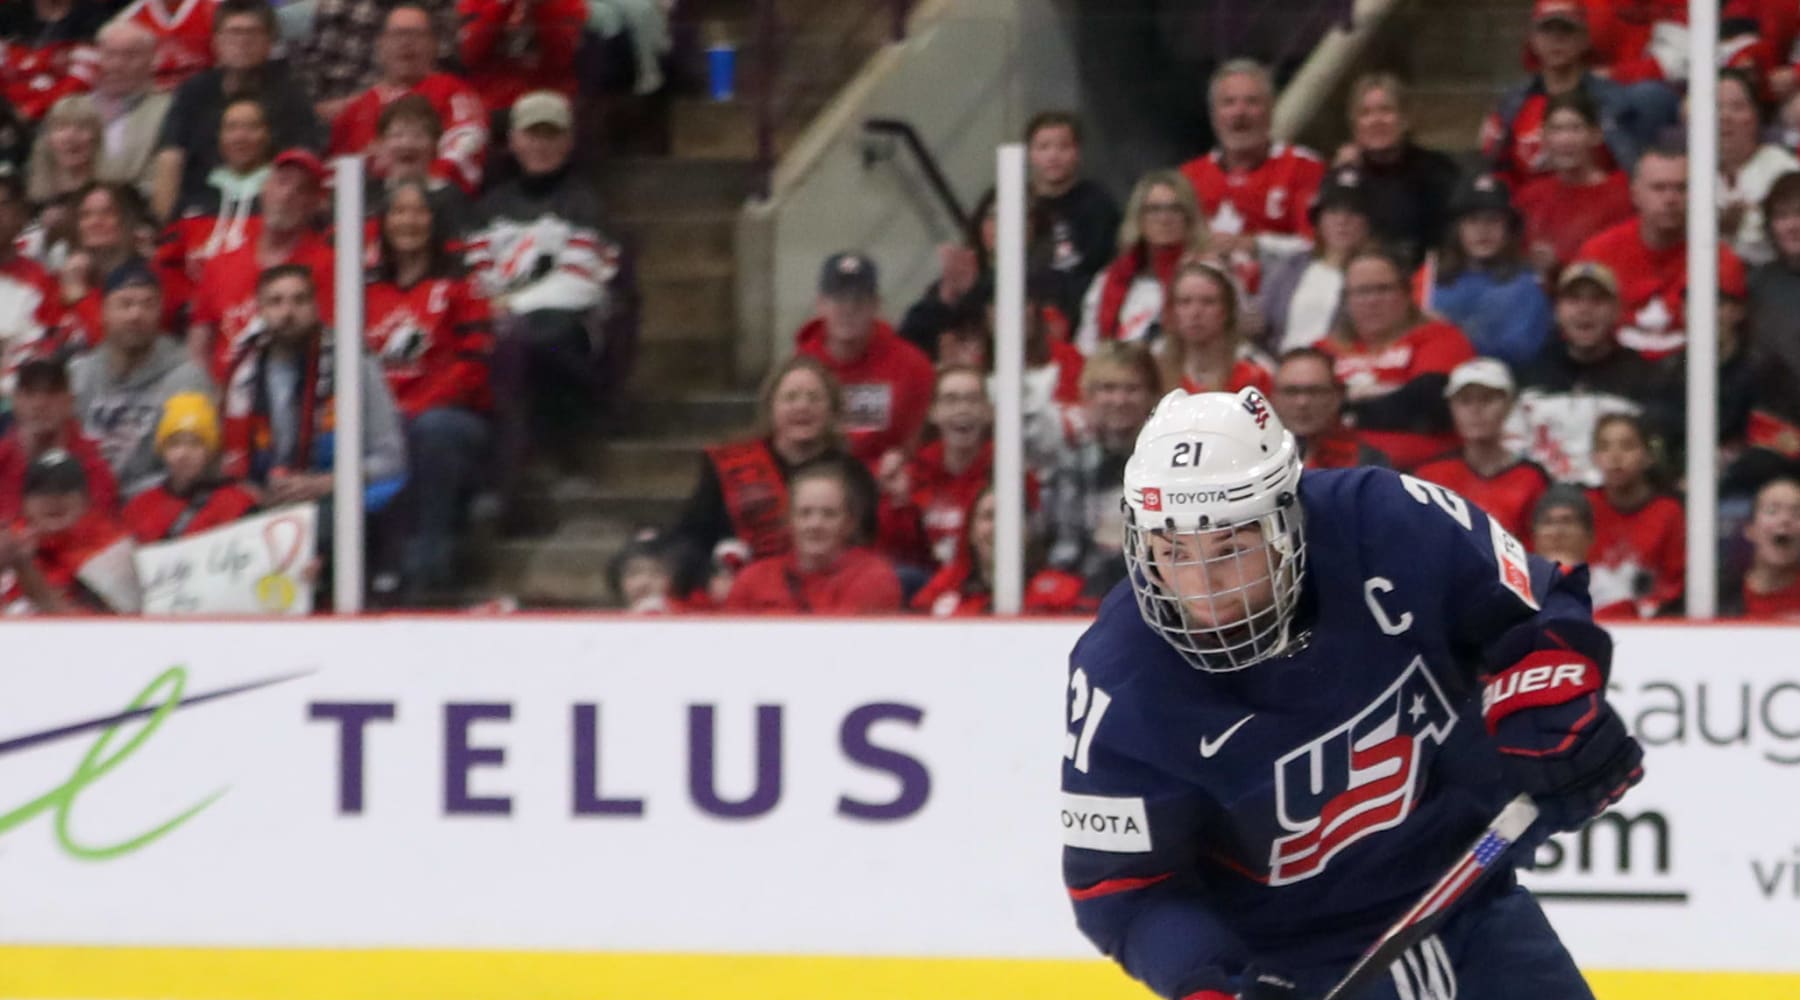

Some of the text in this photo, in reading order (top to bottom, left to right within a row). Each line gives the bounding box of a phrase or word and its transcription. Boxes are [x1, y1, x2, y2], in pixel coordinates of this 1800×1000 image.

[1171, 442, 1203, 468] 21
[1166, 489, 1227, 506] TOYOTA
[1401, 473, 1473, 531] 2
[1364, 577, 1413, 636] C
[1481, 662, 1587, 716] UER
[305, 699, 934, 824] TELUS
[1060, 809, 1142, 836] OYOTA
